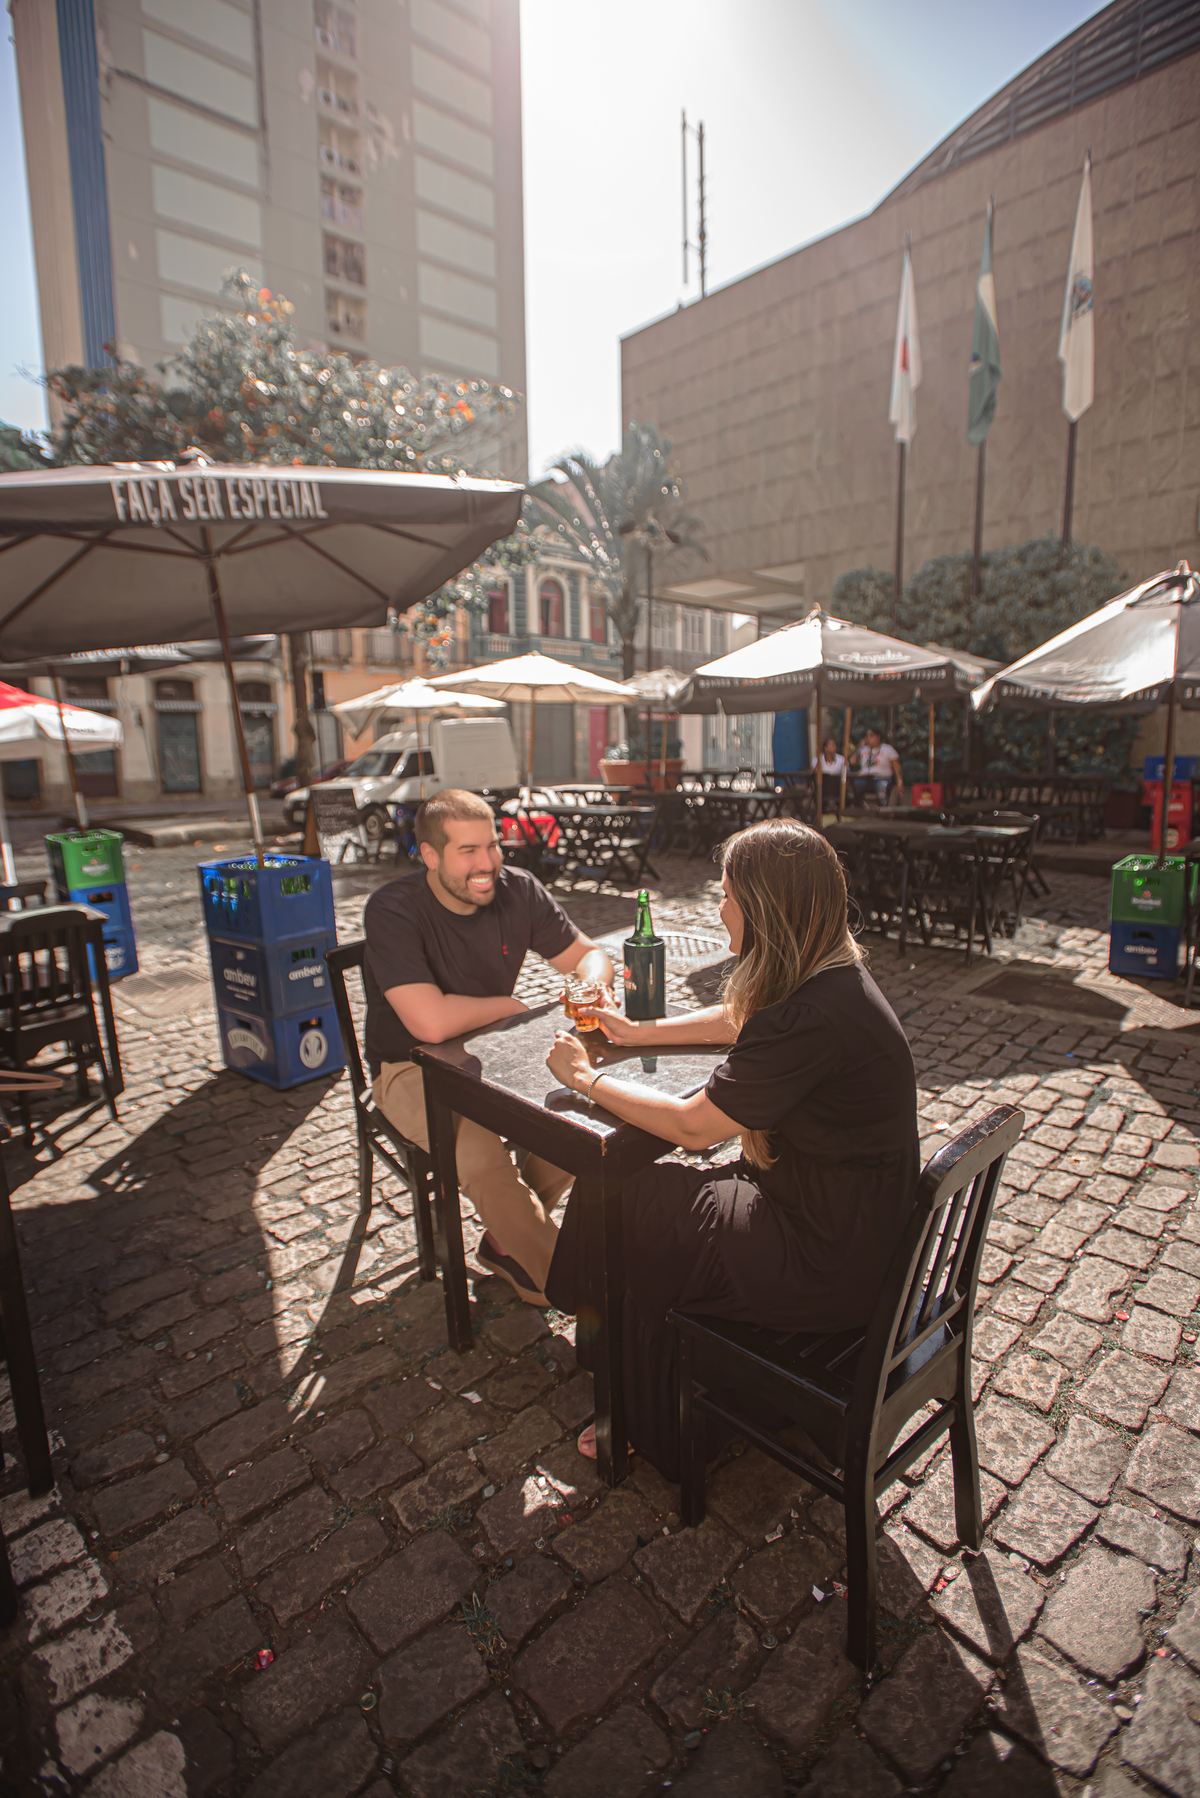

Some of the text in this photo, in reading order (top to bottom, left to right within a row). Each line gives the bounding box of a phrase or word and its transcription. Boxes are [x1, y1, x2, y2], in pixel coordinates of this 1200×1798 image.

[110, 478, 329, 526] FAÇA SER ESPECIAL
[1124, 944, 1158, 955] ambev
[223, 966, 257, 988] ambev
[288, 964, 325, 981] ambev
